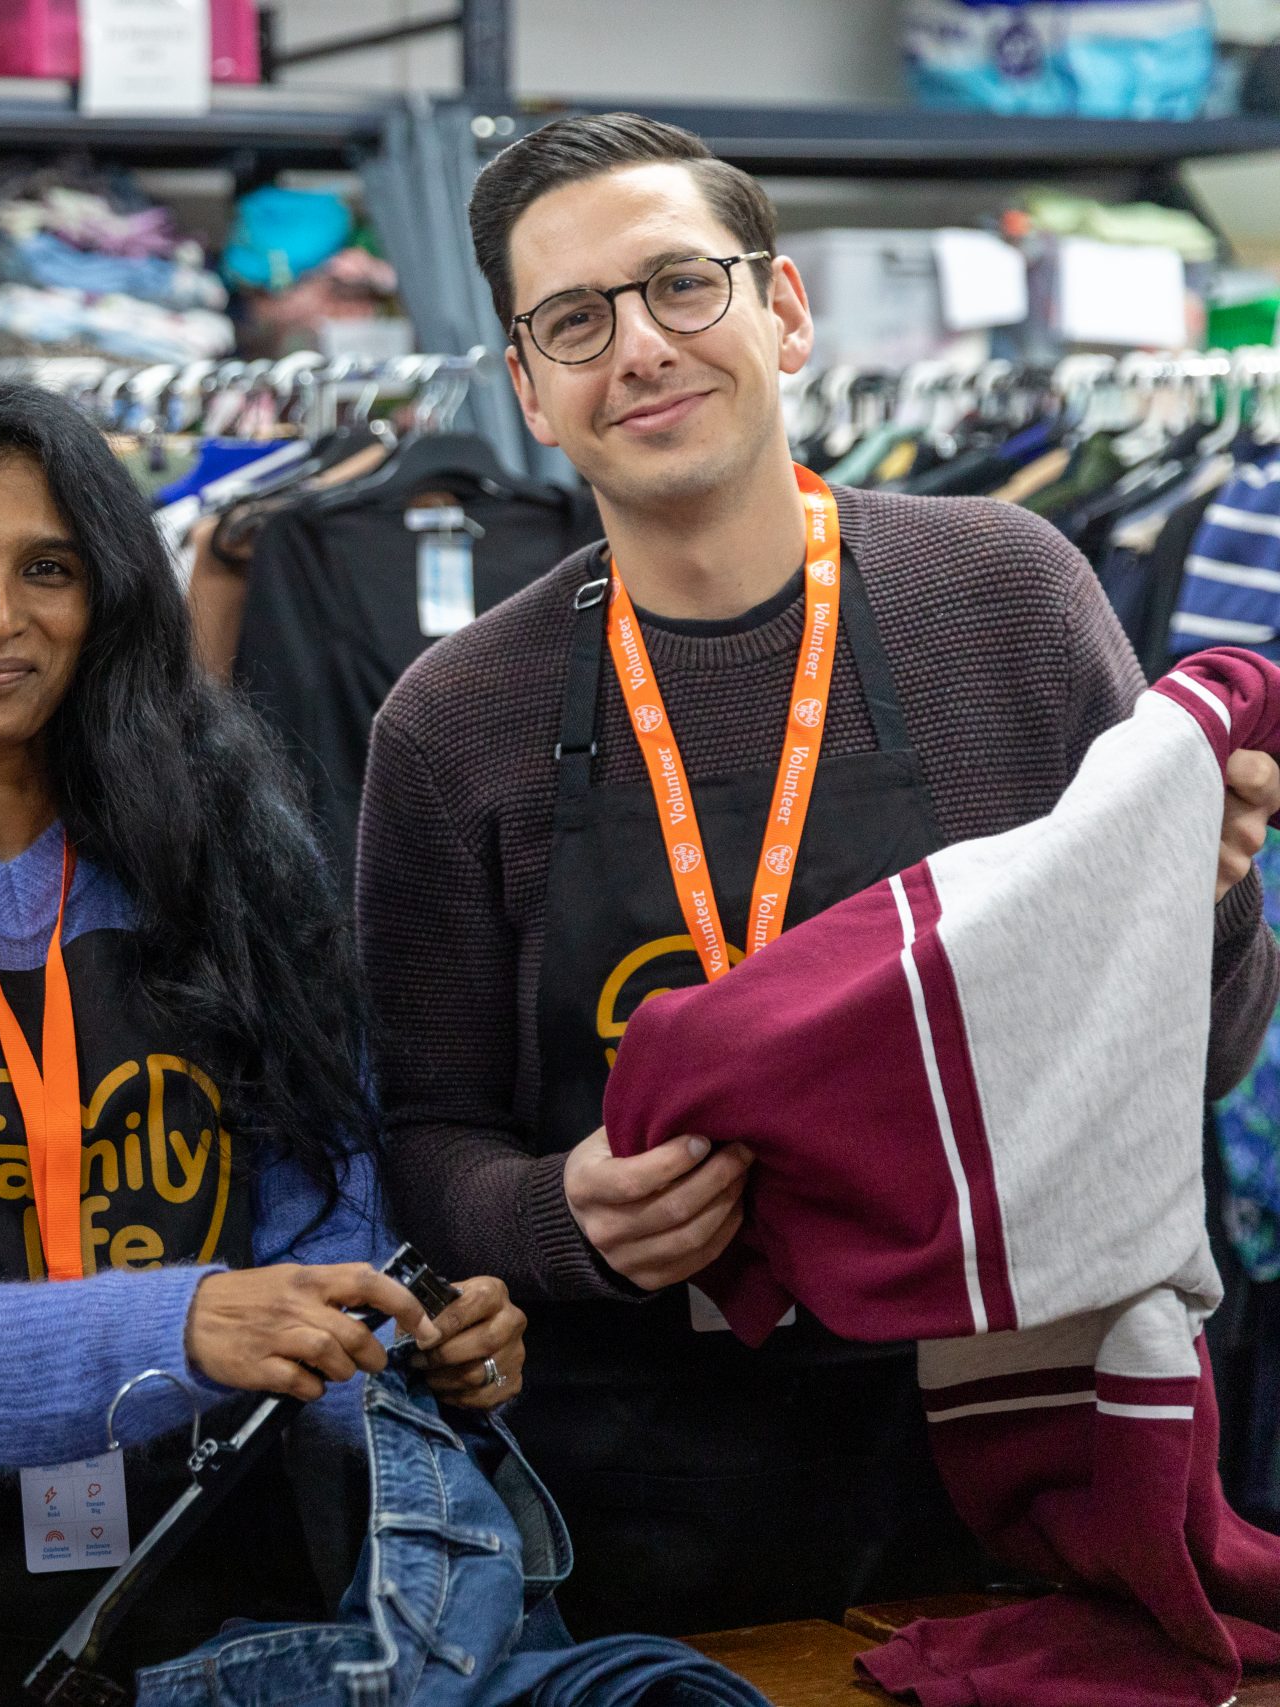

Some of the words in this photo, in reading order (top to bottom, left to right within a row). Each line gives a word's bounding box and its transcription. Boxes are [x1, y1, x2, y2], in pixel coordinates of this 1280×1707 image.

[619, 615, 647, 690] Volunteer
[804, 602, 830, 680] Volunteer
[658, 747, 687, 825] Volunteer
[777, 746, 810, 826] Volunteer
[692, 890, 723, 973] Volunteer
[23, 1195, 164, 1283] lfe
